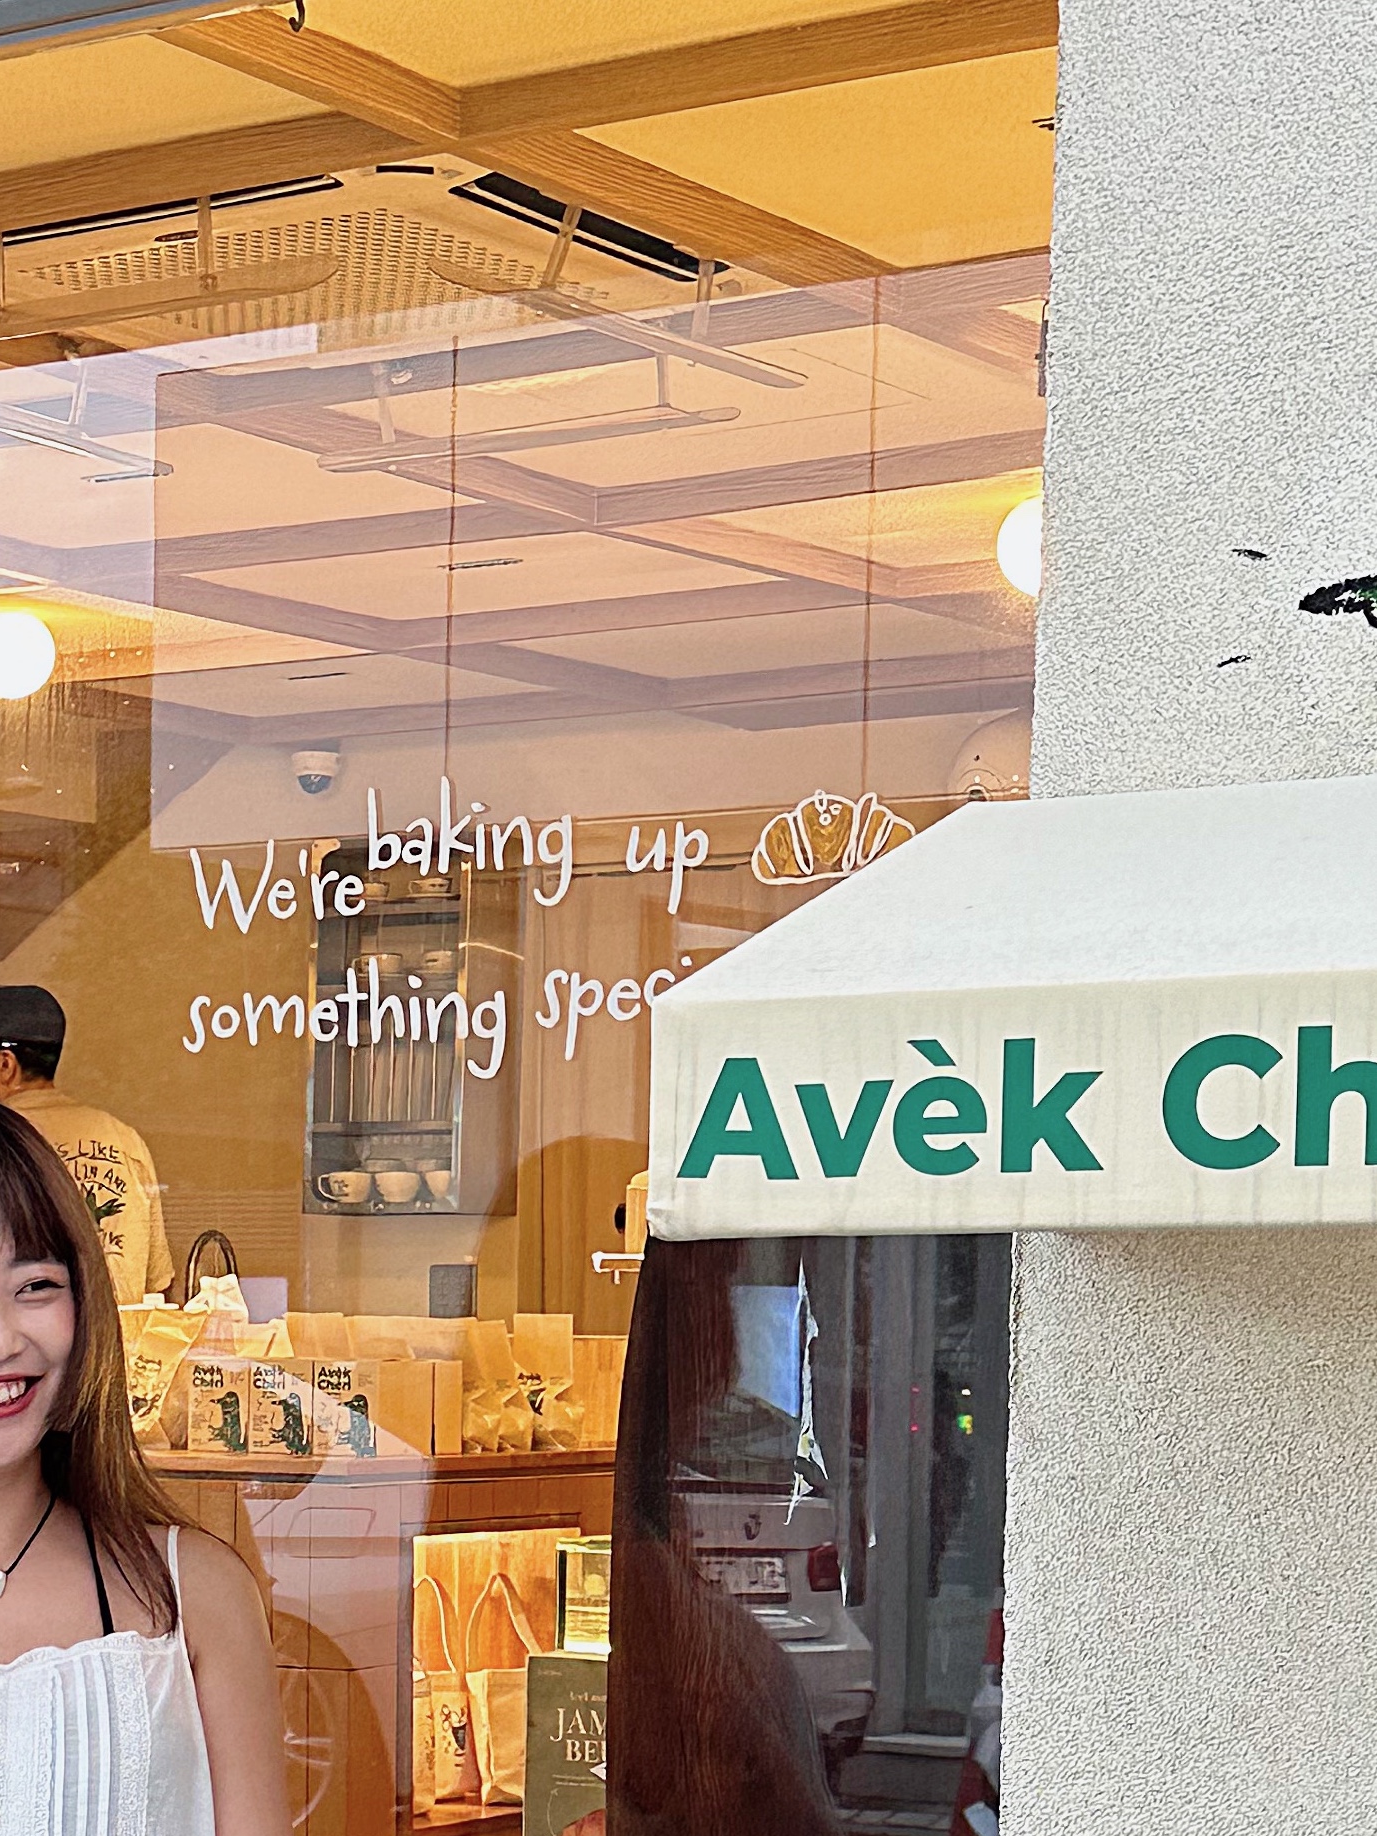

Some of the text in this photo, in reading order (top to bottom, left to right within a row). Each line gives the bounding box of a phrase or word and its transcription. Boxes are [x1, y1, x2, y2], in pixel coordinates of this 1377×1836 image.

[189, 775, 709, 934] We're baking up
[183, 955, 693, 1079] something spec
[675, 1025, 1377, 1180] Avèk Ch
